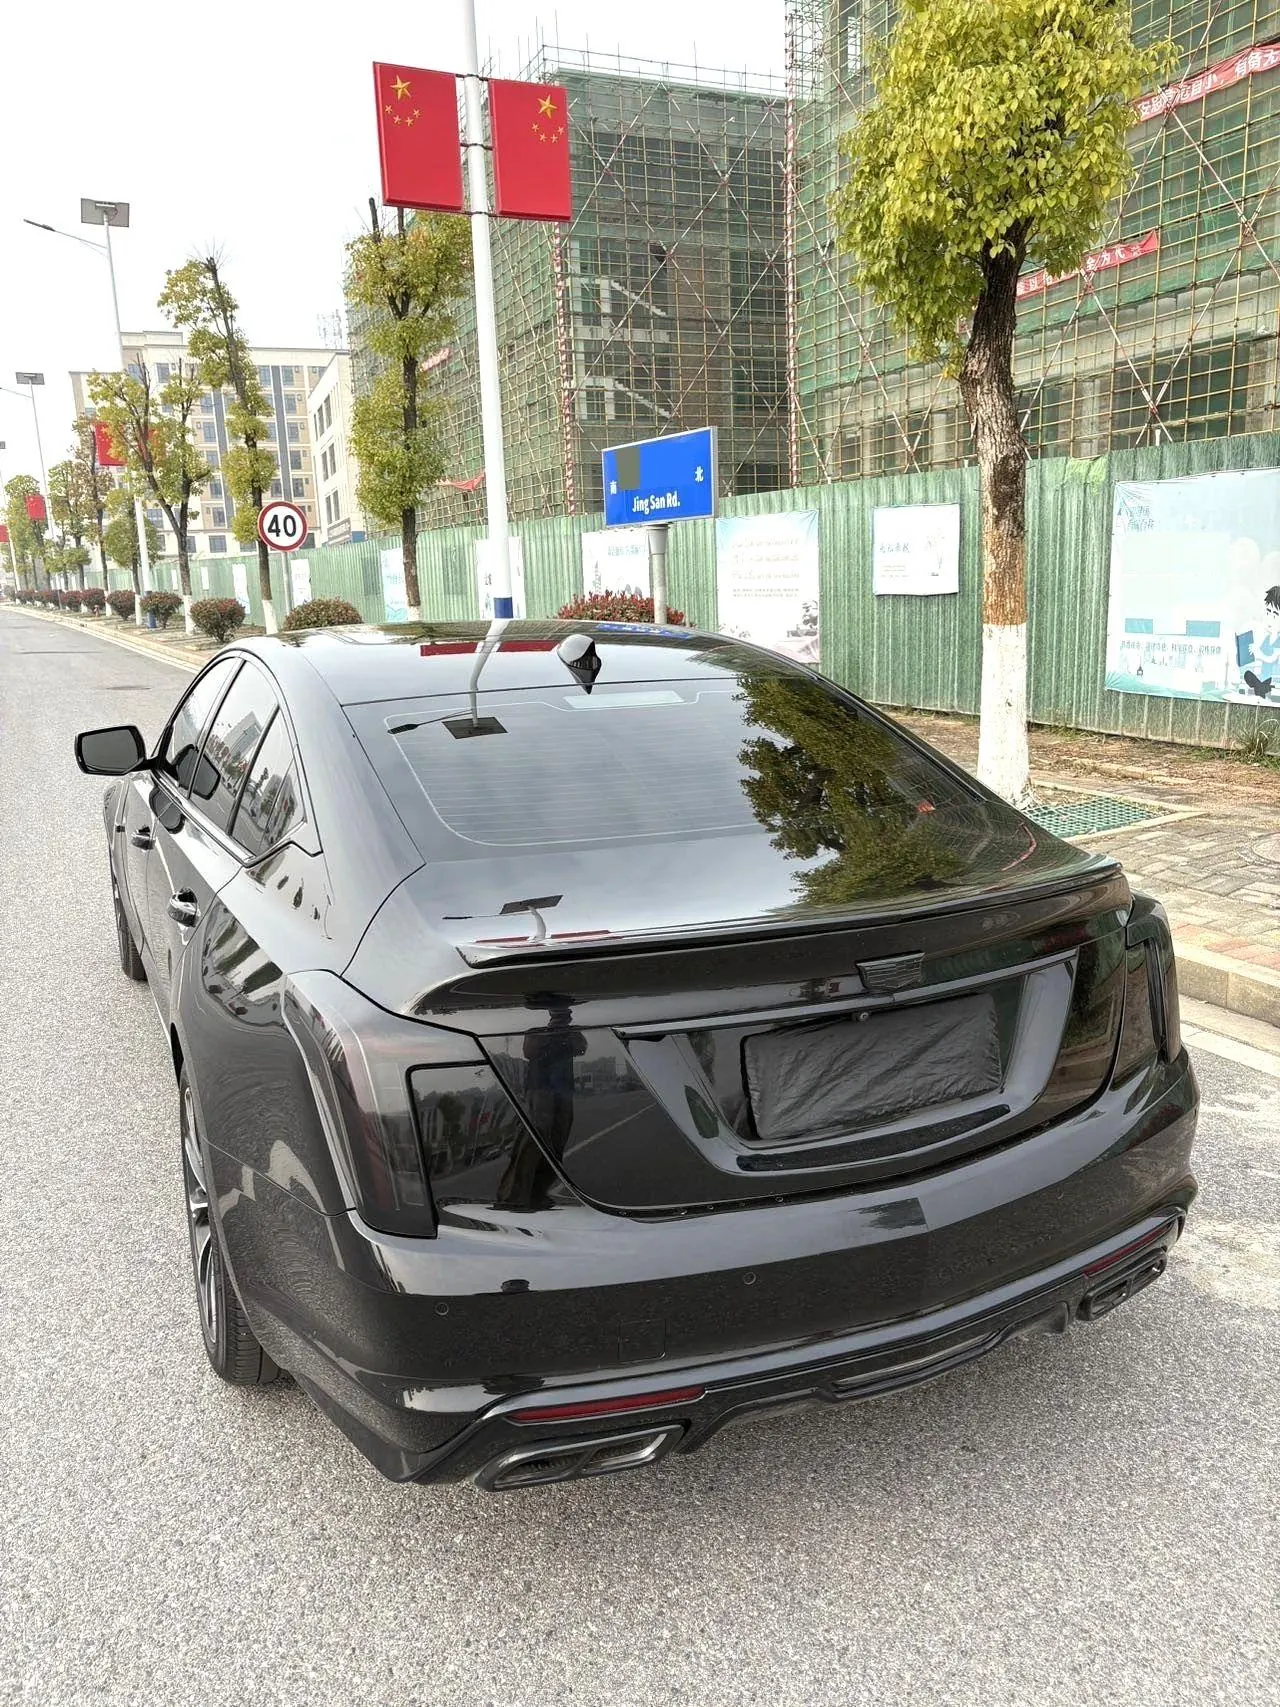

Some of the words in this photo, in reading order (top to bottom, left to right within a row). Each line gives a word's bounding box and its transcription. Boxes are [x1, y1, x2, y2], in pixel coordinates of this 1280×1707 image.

[695, 466, 703, 482] 北
[632, 496, 650, 515] Jing
[650, 495, 665, 509] San
[667, 491, 680, 508] Rd.
[267, 514, 297, 538] 40
